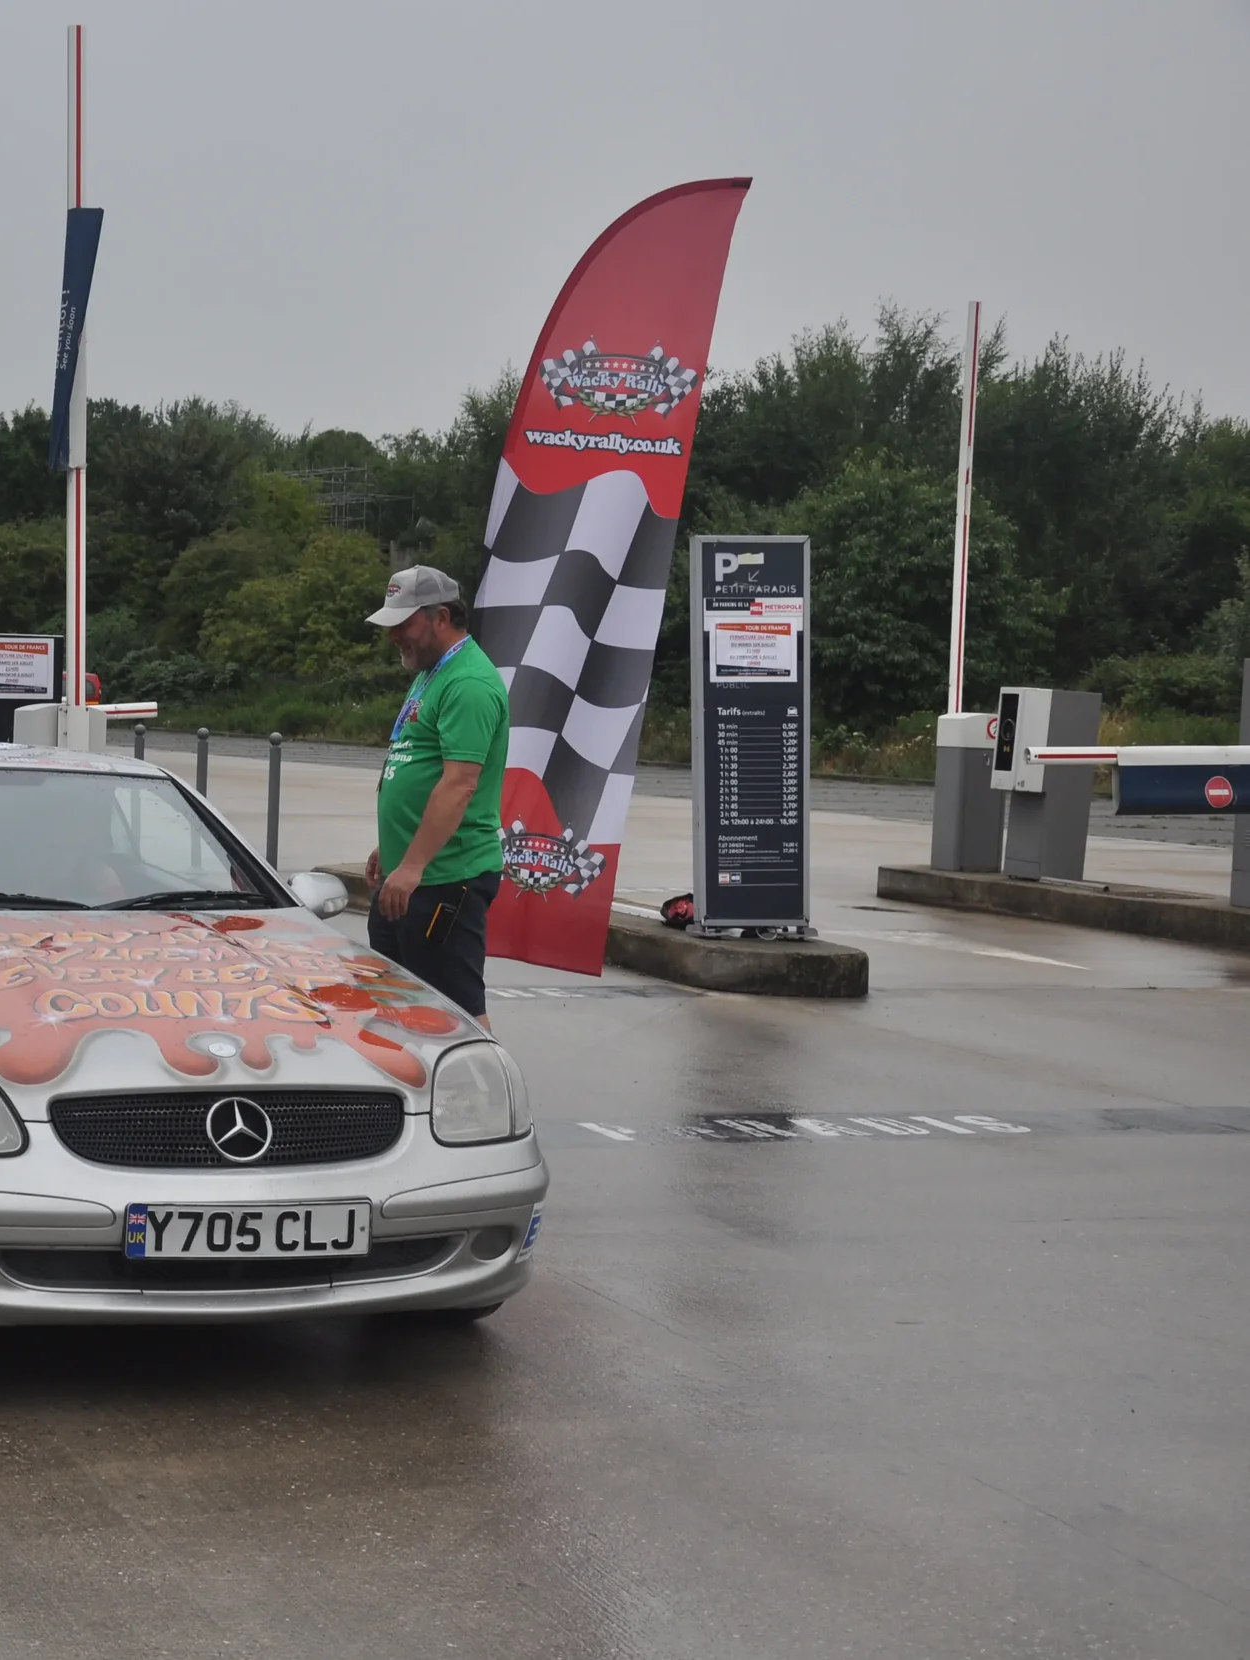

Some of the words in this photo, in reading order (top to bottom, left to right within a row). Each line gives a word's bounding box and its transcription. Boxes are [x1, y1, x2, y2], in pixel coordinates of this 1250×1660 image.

[67, 306, 76, 331] soon
[64, 332, 72, 350] you
[60, 352, 69, 370] See
[566, 373, 623, 389] Wacky
[624, 375, 666, 396] Rally
[525, 430, 681, 455] wackyrally.co.uk
[715, 553, 739, 582] P
[716, 584, 744, 594] PETIT
[749, 584, 797, 594] PARADIS
[717, 707, 741, 716] Tarifs
[504, 851, 540, 866] Wacky
[541, 854, 576, 877] Rally
[91, 947, 191, 963] LIFE
[33, 984, 328, 1023] COUNTS
[128, 1231, 145, 1244] UK
[148, 1210, 263, 1252] Y705
[276, 1209, 355, 1251] CLJ
